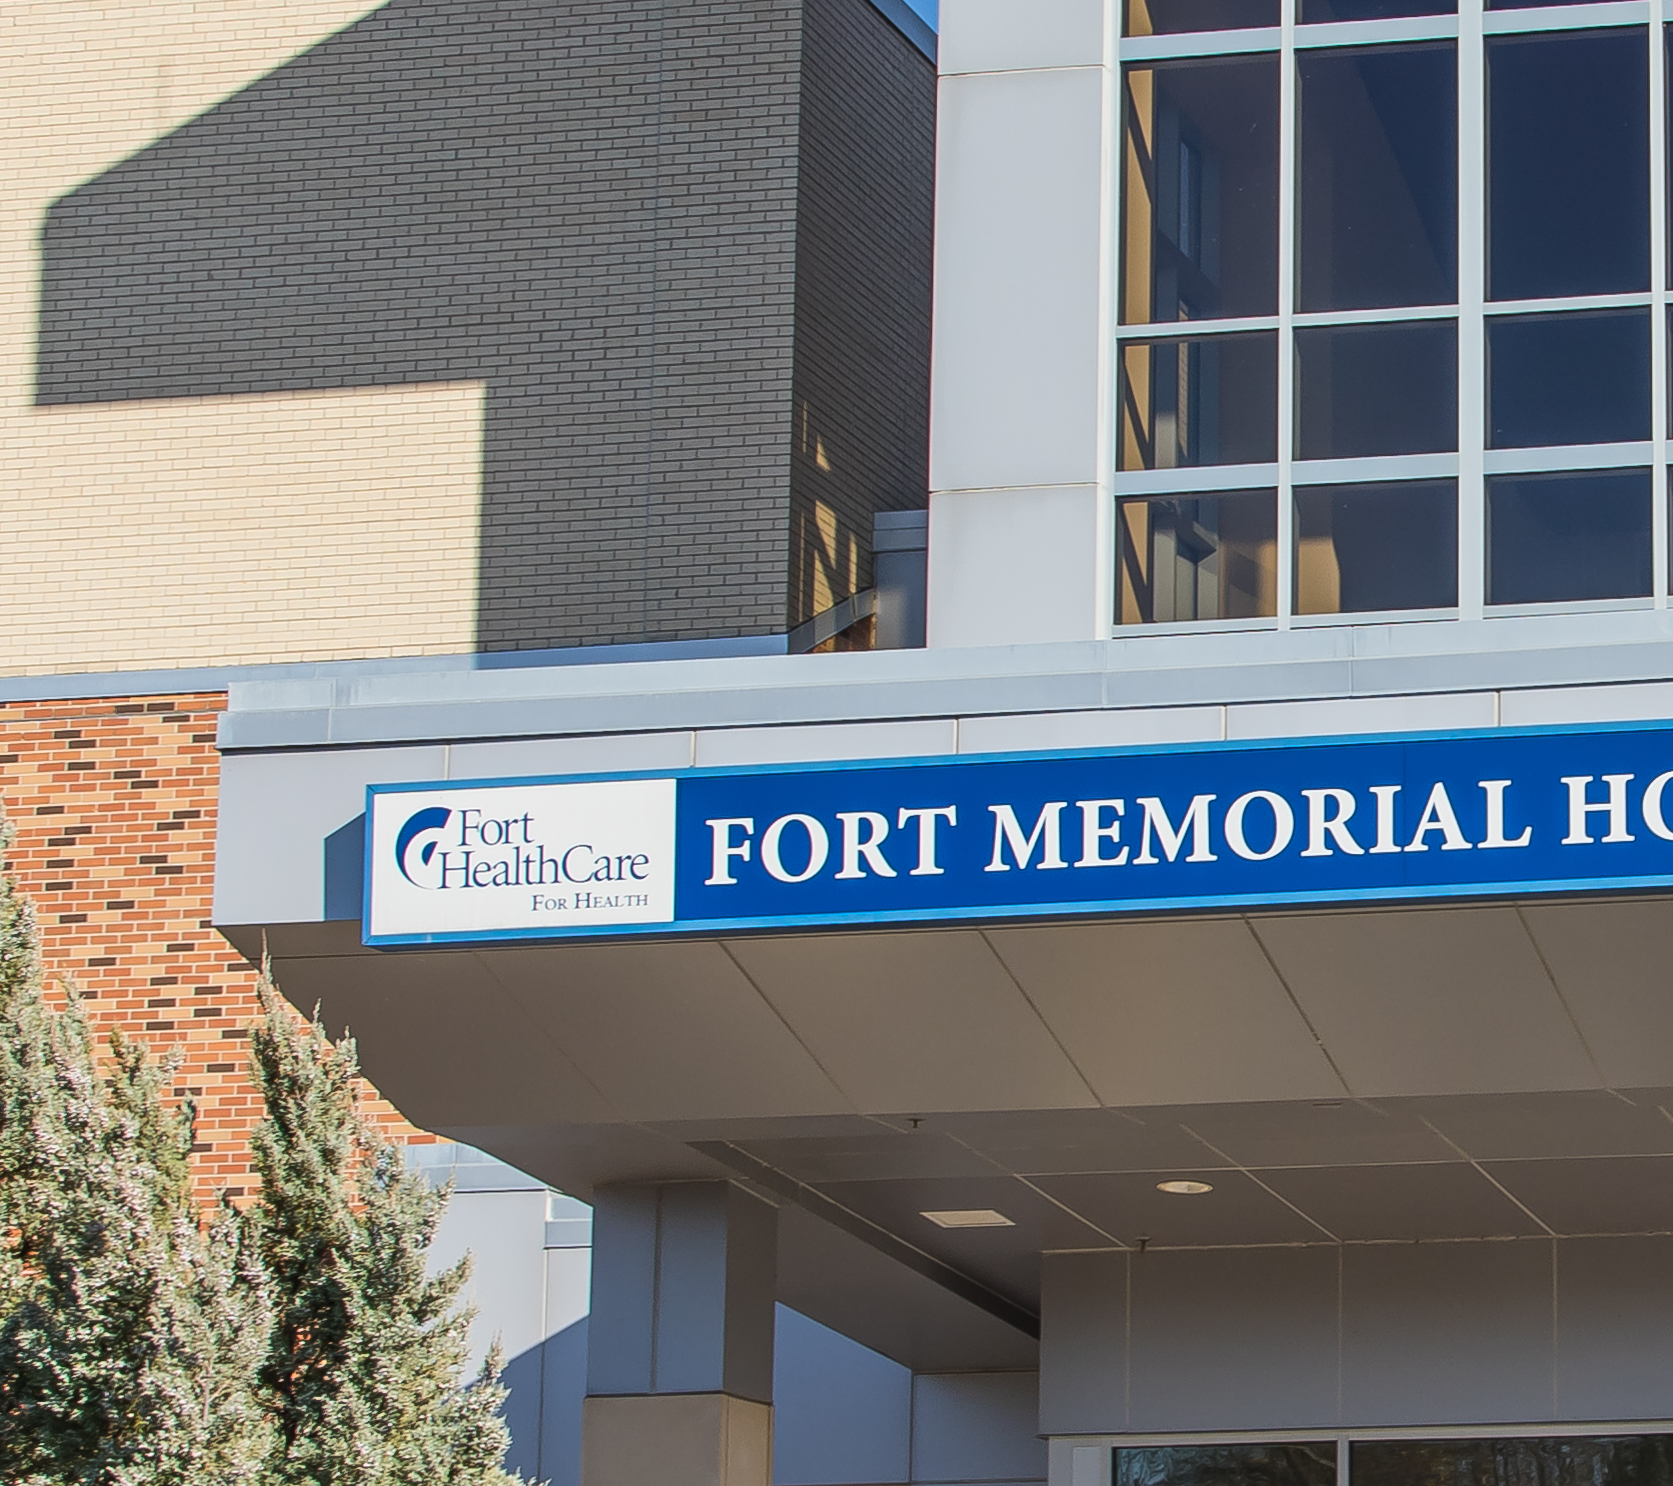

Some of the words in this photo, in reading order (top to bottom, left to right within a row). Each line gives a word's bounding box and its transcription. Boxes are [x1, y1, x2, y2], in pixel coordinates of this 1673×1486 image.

[456, 808, 535, 847] Fort
[705, 806, 956, 885] FORT
[985, 781, 1532, 871] MEMORIAL
[436, 844, 650, 890] HealthCare
